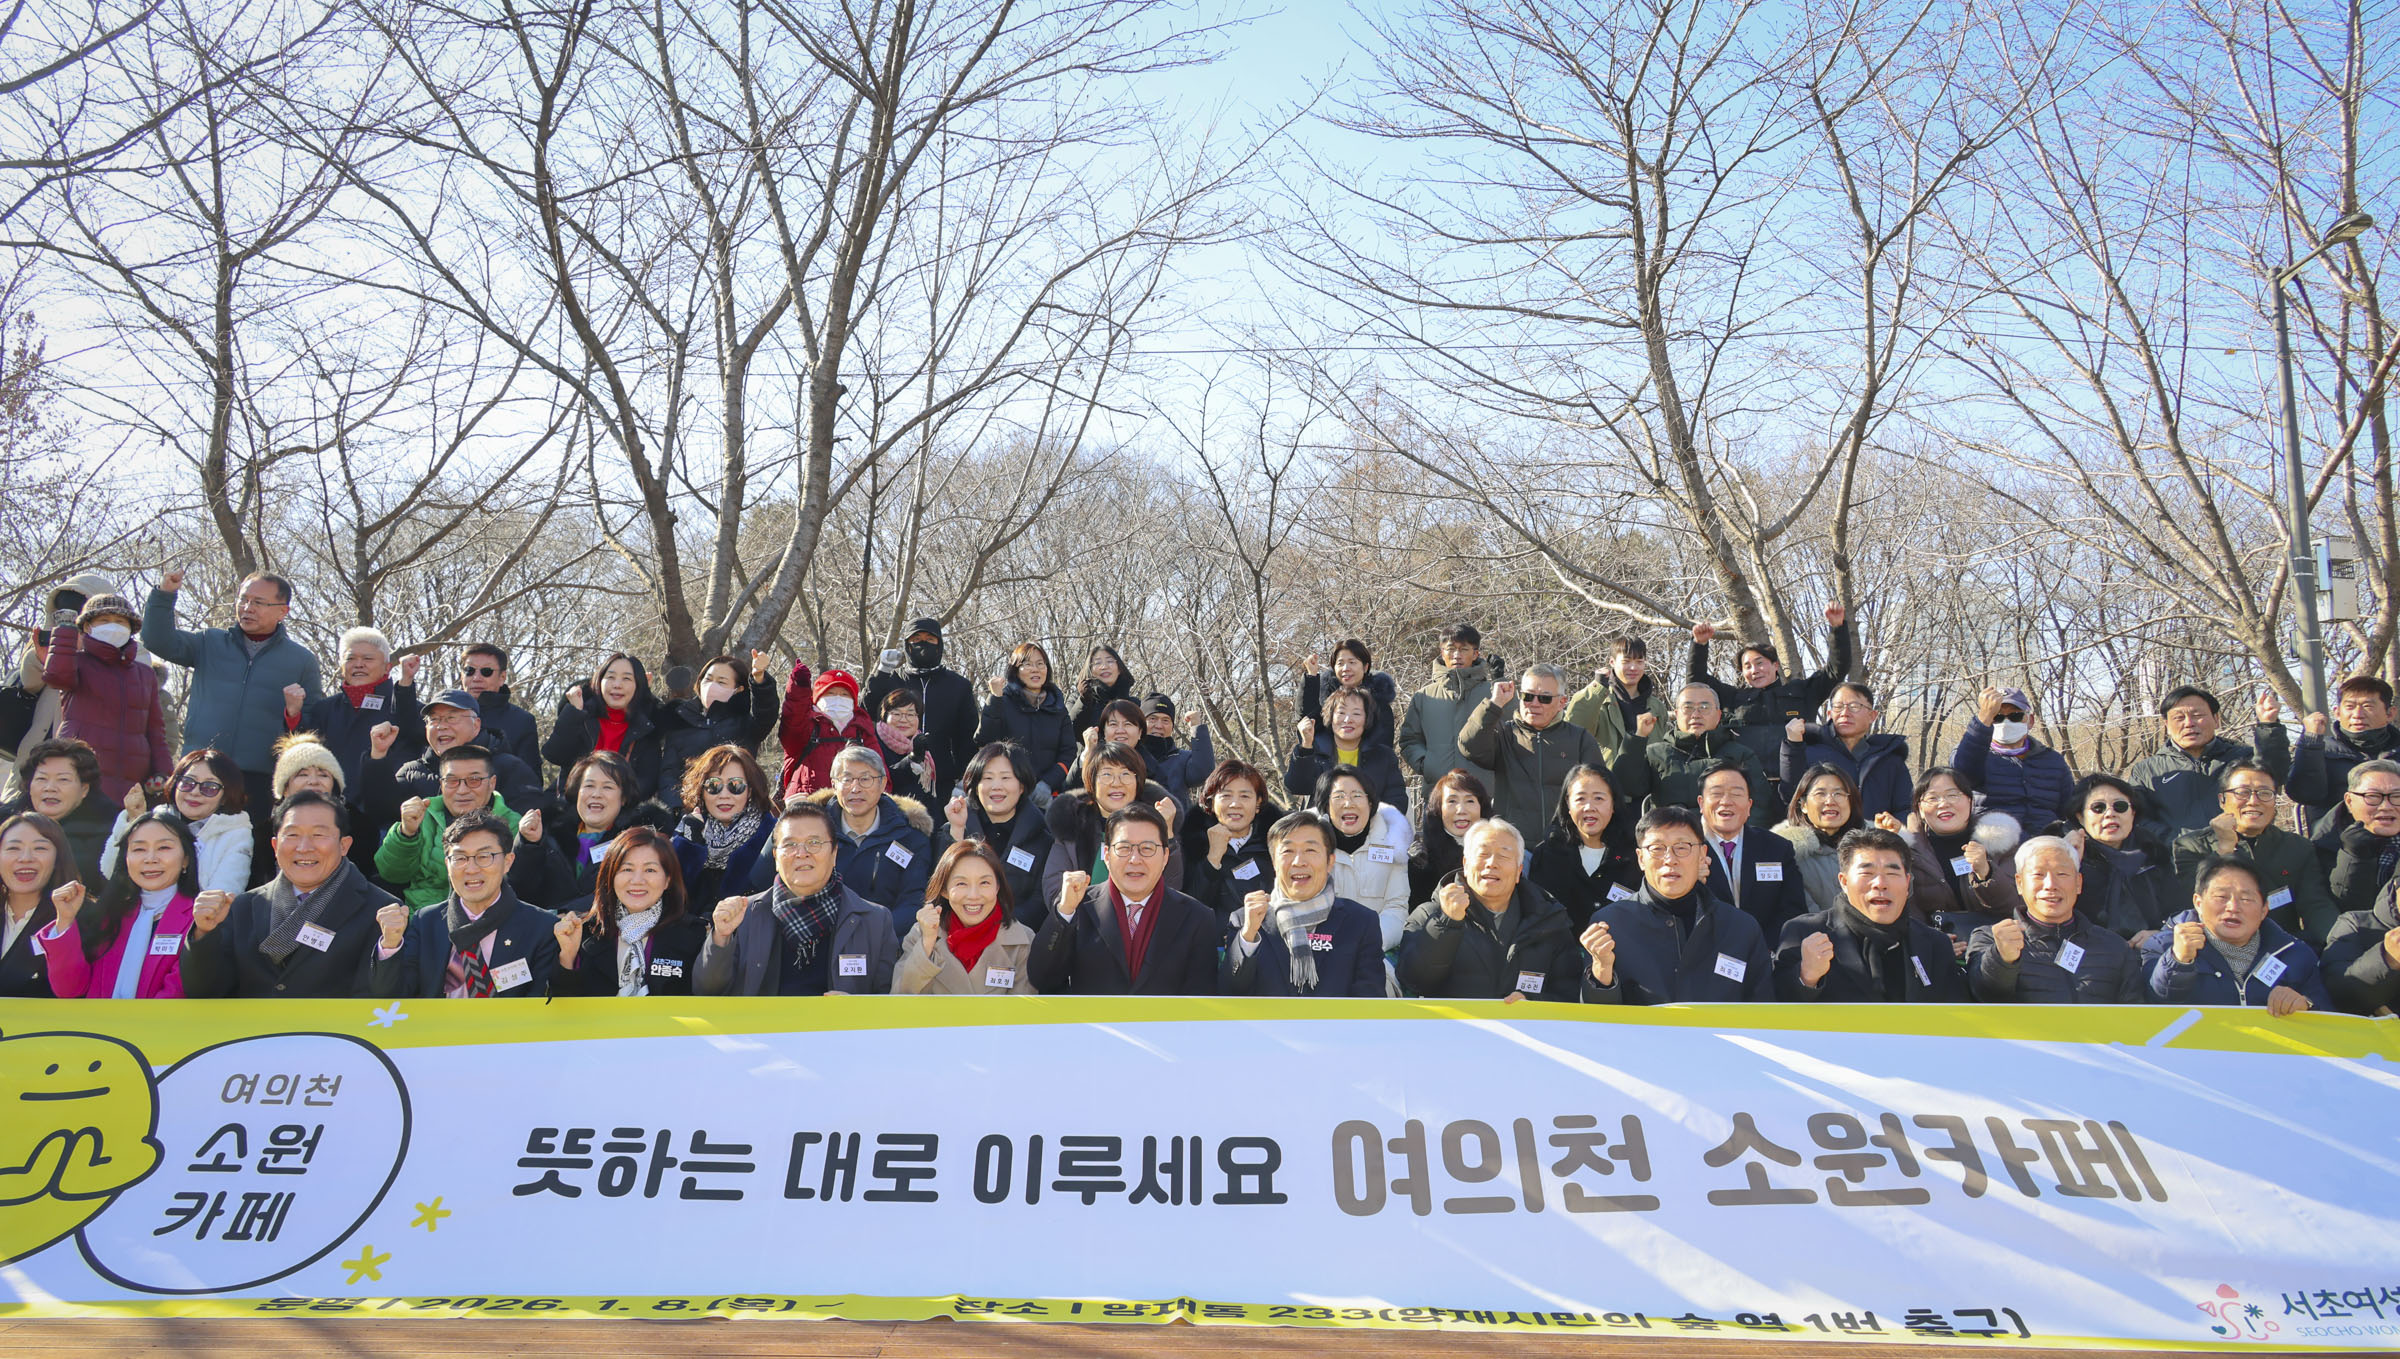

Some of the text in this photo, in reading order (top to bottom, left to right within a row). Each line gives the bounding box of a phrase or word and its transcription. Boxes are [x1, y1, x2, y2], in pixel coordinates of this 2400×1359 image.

[1308, 939, 1334, 952] 성수
[650, 964, 683, 978] 안종숙
[220, 1072, 343, 1107] 여의천
[187, 1123, 326, 1176] 소원
[512, 1111, 2168, 1217] 뜻하는 대로 이루세요 여의천 소원카페
[153, 1191, 297, 1243] 카페
[254, 1296, 367, 1311] 운영
[422, 1297, 571, 1311] 2026.
[597, 1298, 629, 1311] 1.
[651, 1295, 797, 1313] 8.(목)
[1102, 1297, 1249, 1320] 양재동
[1268, 1304, 1652, 1329] 233(양재시민의
[1670, 1311, 1722, 1331] 숲
[1735, 1311, 1792, 1333] 역
[1803, 1310, 1890, 1335] 1번
[1904, 1307, 2032, 1339] 출구)
[2296, 1326, 2364, 1337] SEOCHO
